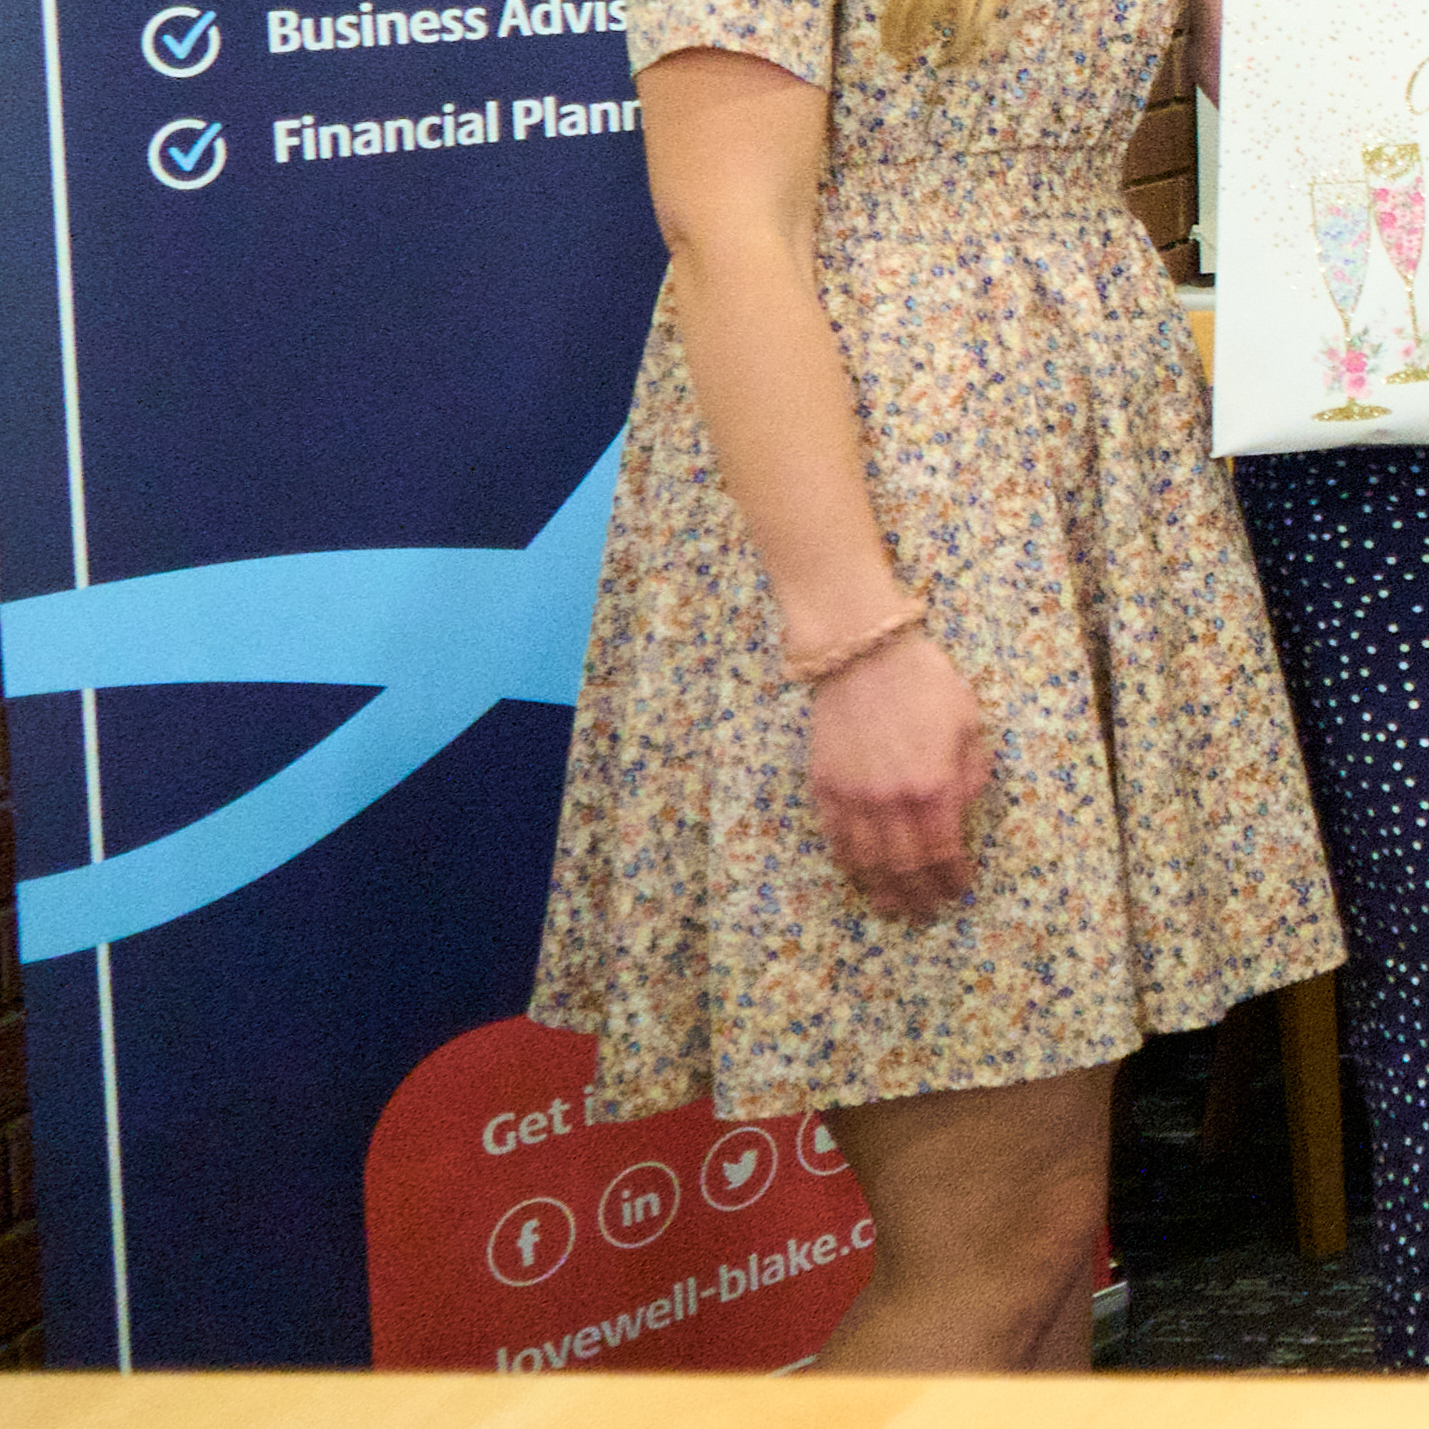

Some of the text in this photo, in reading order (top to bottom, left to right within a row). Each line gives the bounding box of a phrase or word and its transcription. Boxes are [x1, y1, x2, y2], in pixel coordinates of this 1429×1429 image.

[267, 2, 488, 54] Business
[273, 100, 499, 163] Financial
[482, 1097, 572, 1155] Get
